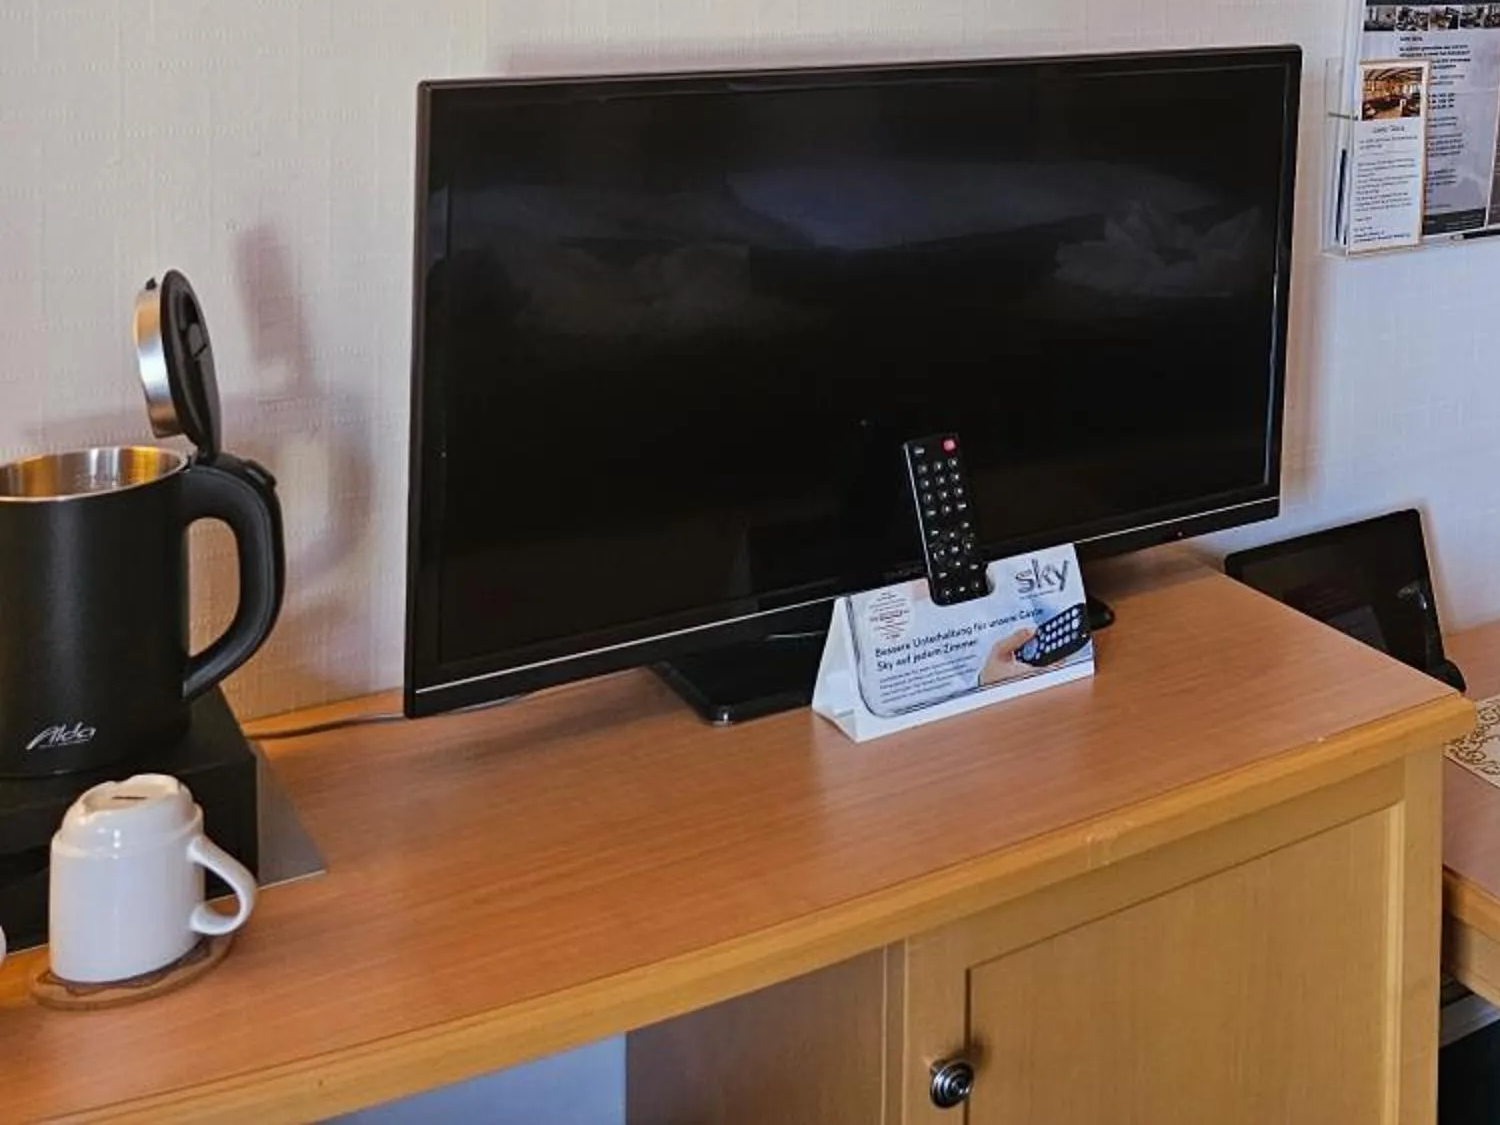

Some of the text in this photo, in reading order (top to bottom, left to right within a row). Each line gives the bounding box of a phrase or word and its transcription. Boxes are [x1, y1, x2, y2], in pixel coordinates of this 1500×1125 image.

[1015, 558, 1068, 594] sky
[912, 627, 973, 648] Unterhaltung
[876, 660, 893, 672] Sky
[895, 654, 911, 666] auf
[942, 638, 978, 655] Zimmer
